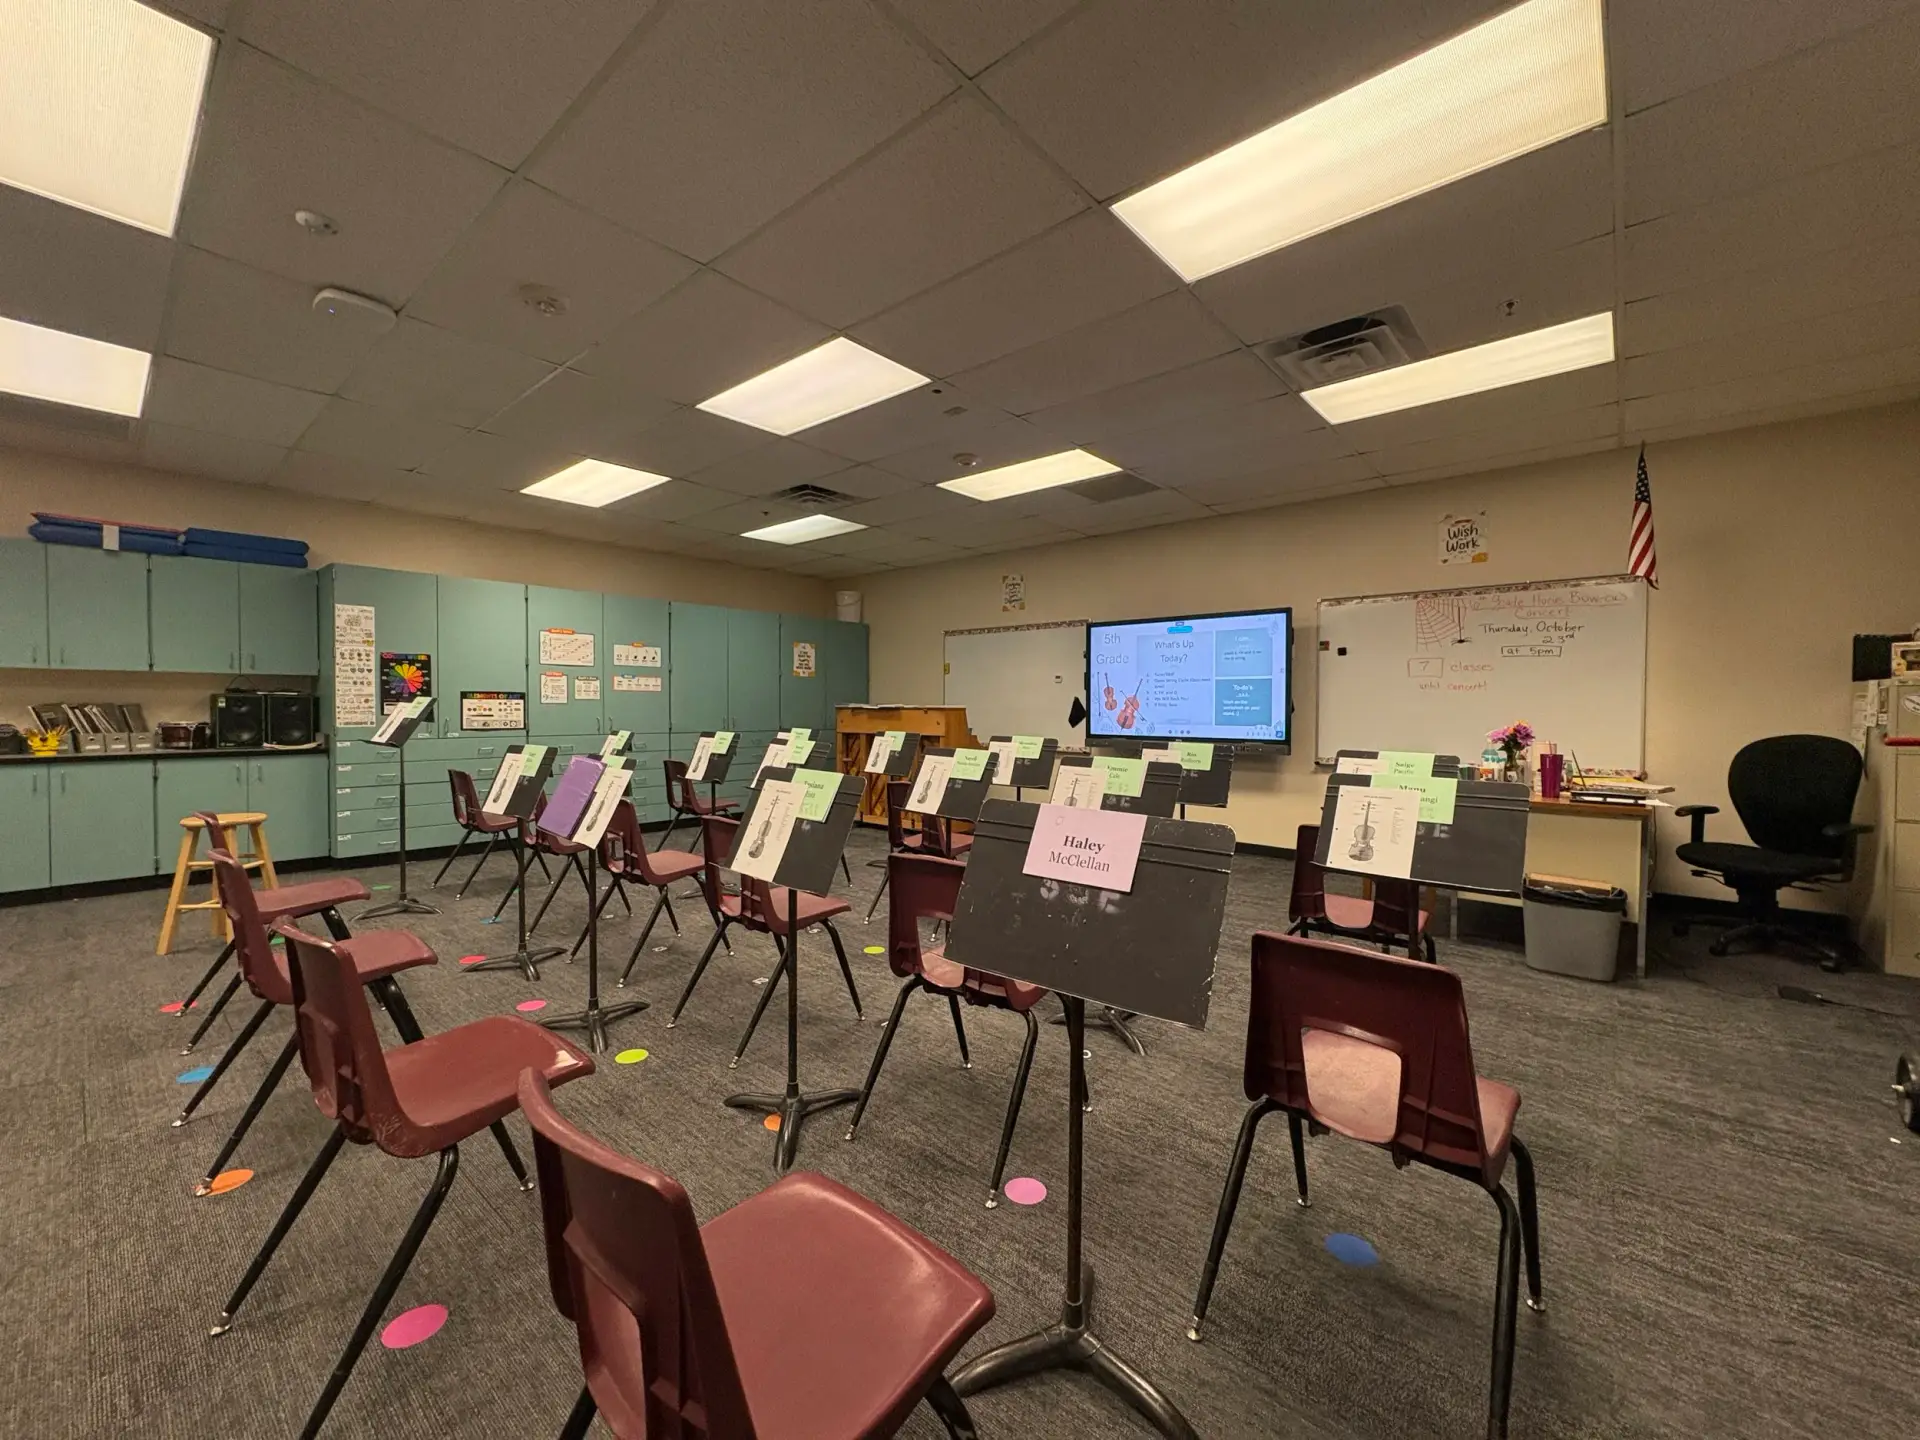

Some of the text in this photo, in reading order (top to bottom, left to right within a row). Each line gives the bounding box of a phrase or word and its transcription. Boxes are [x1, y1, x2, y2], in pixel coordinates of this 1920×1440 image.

[1447, 523, 1479, 541] Wish
[1446, 536, 1481, 553] Work
[1536, 620, 1586, 633] October
[1104, 633, 1121, 644] 5th
[1154, 640, 1194, 650] What's Up
[1506, 646, 1555, 657] at 5pm
[1096, 653, 1130, 664] Grade
[1160, 654, 1188, 664] Today?
[1419, 660, 1495, 672] 7 classes
[1063, 835, 1106, 855] Haley
[1048, 850, 1111, 873] McClellan
